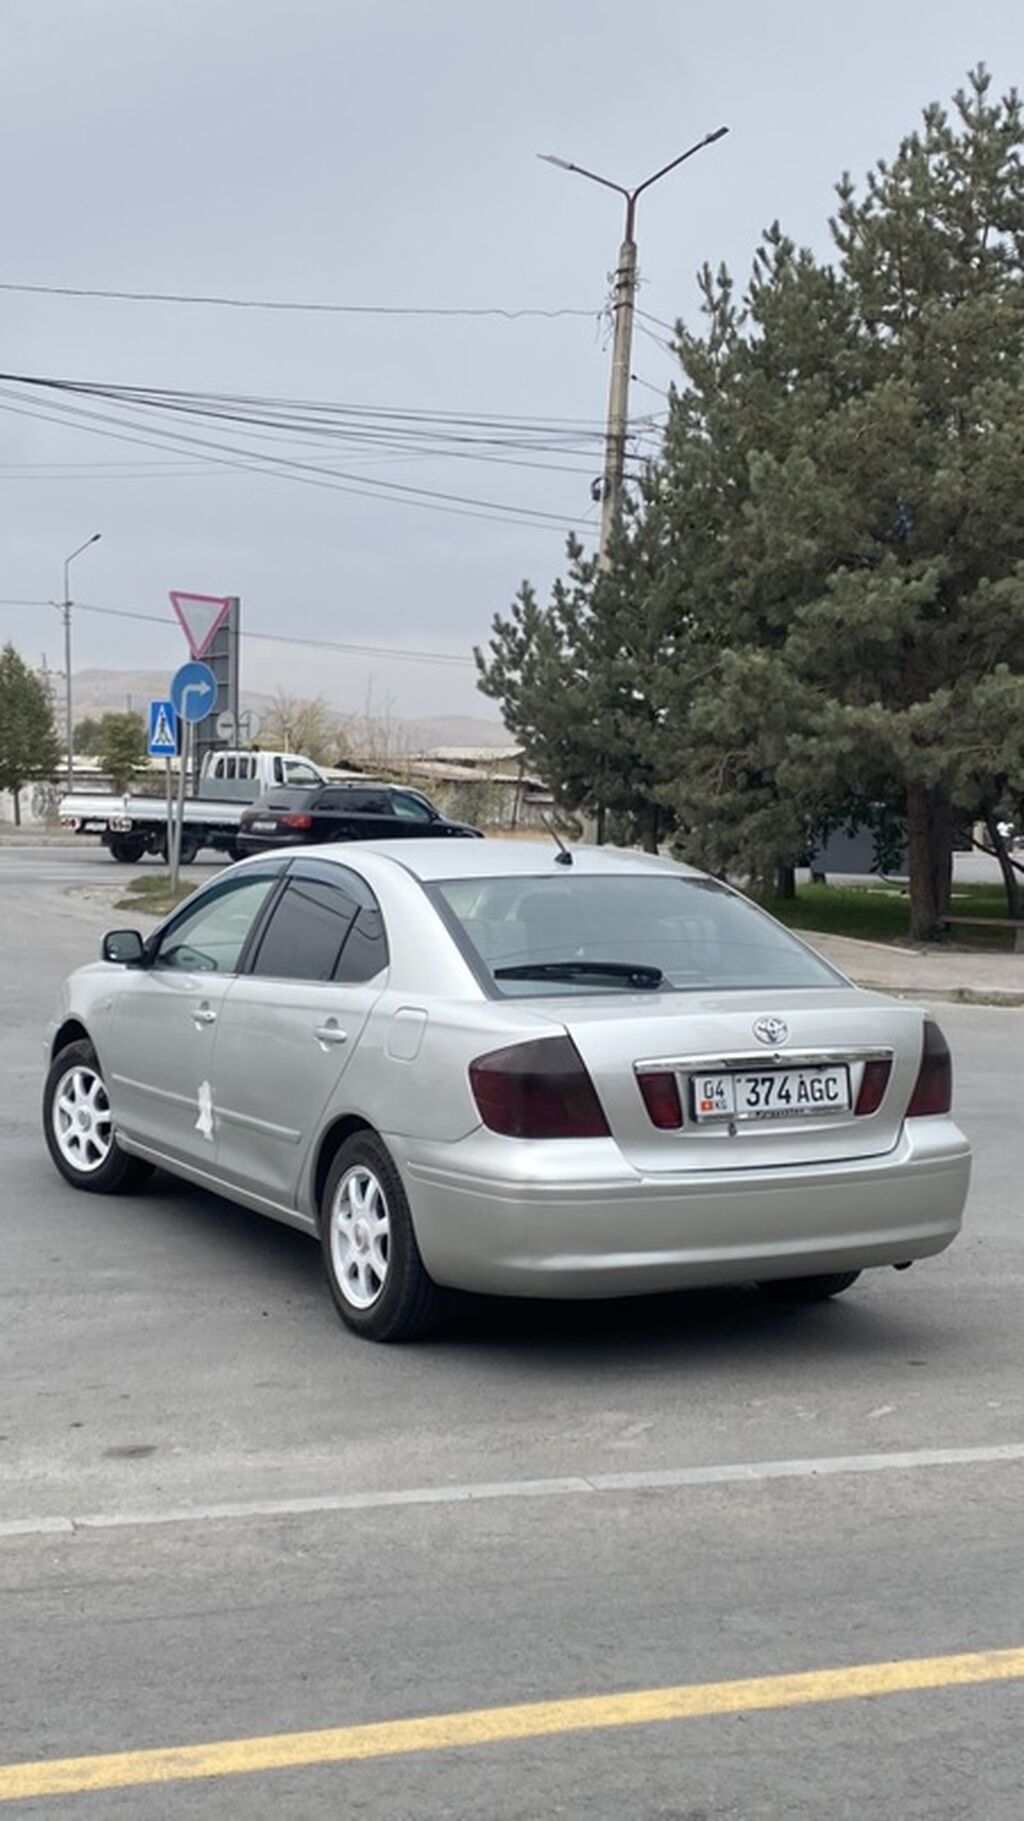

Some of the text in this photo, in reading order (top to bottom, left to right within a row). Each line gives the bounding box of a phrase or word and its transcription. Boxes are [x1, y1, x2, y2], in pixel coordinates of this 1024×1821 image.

[703, 1080, 725, 1100] 04
[745, 1076, 839, 1107] 374 AGC
